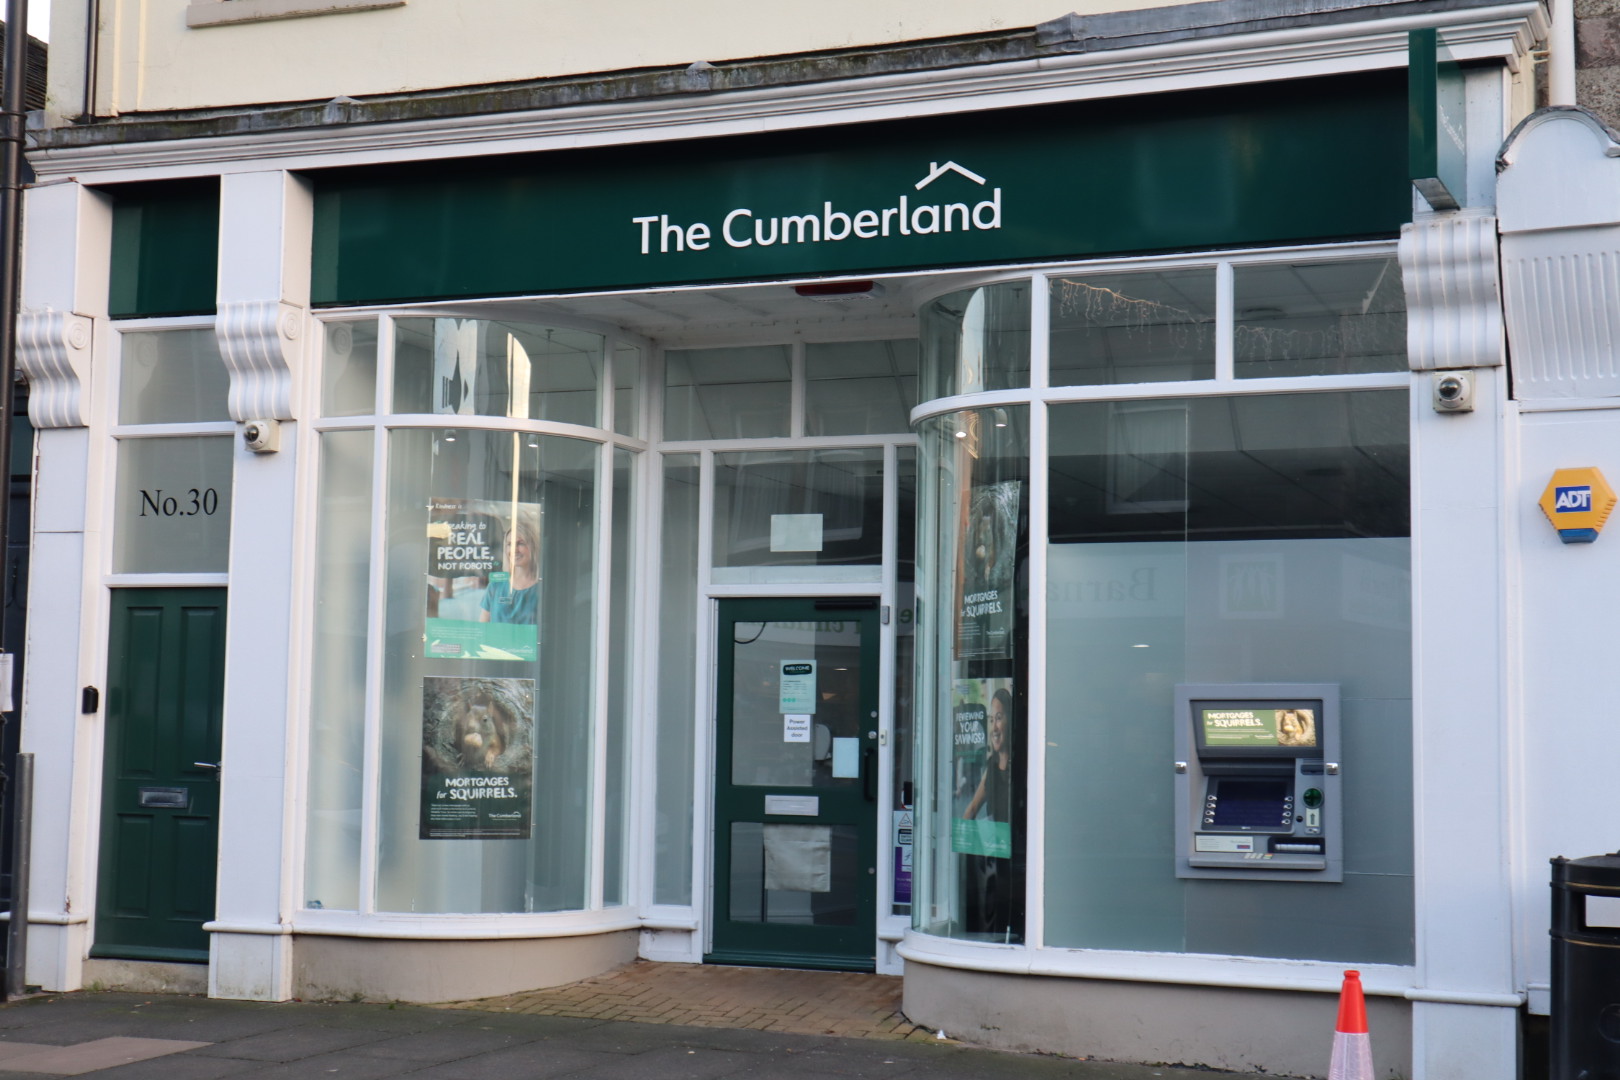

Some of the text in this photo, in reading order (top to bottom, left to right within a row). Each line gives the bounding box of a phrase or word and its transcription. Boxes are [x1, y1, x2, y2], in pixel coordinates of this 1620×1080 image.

[632, 188, 1002, 254] The Cumberland
[139, 487, 218, 517] No.30
[1556, 490, 1591, 508] ADT
[479, 521, 487, 531] to
[448, 532, 485, 545] REAL
[437, 547, 494, 560] PEOPLE,
[438, 562, 493, 571] NOT ROBOTS
[964, 590, 998, 604] MORTGAGES
[960, 721, 979, 733] YOUR
[1214, 718, 1264, 727] SQUIRRELS.
[954, 732, 985, 746] SAVINGS?
[445, 777, 509, 787] MORTGAGES
[436, 788, 518, 800] for SQUIRRELS.
